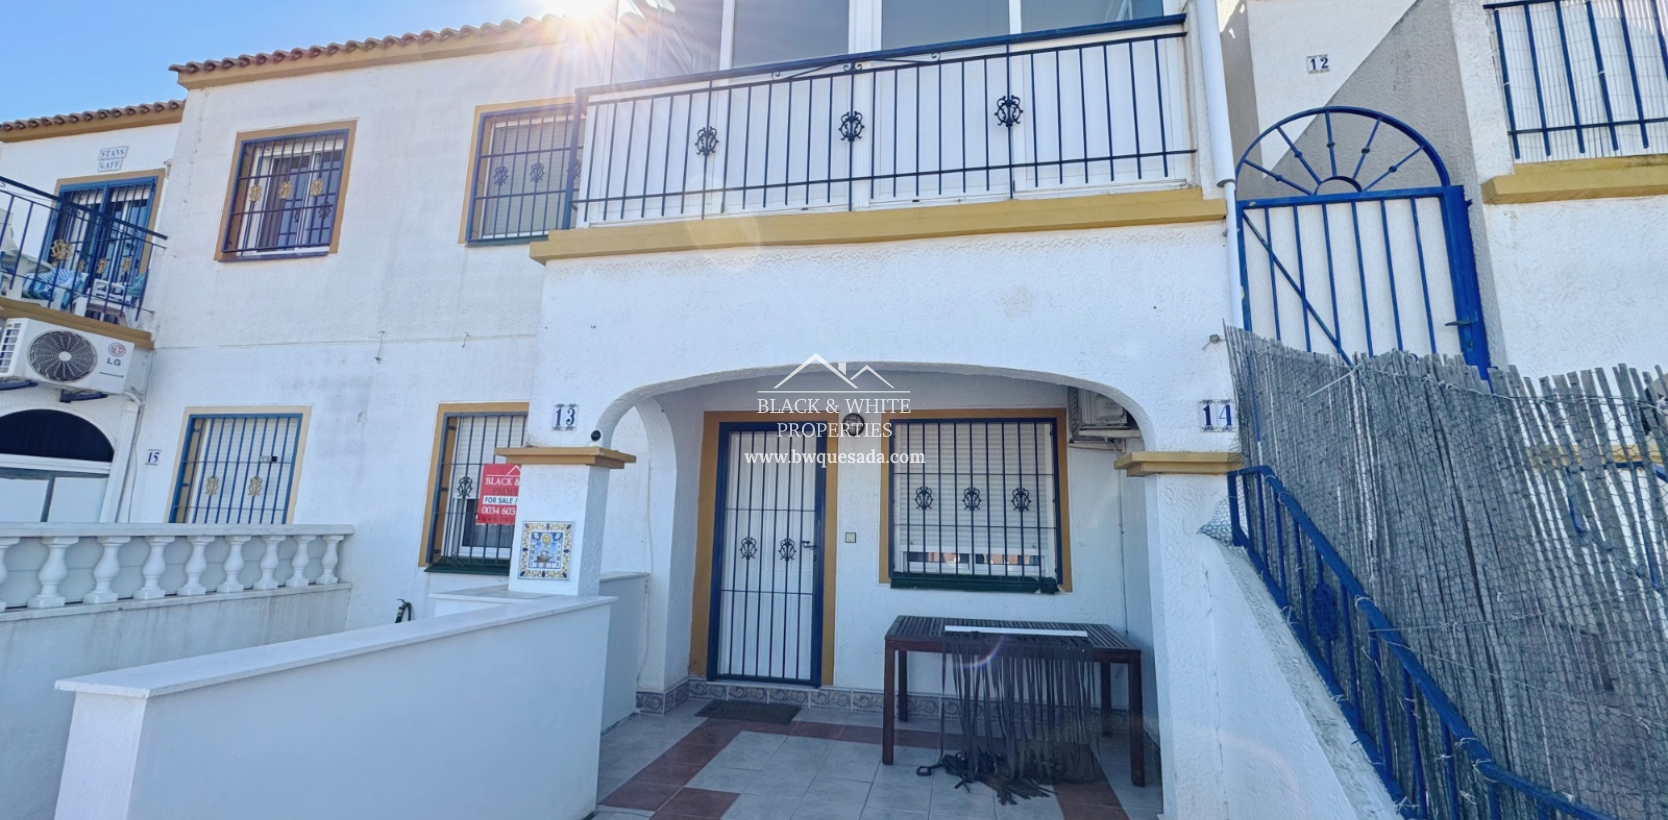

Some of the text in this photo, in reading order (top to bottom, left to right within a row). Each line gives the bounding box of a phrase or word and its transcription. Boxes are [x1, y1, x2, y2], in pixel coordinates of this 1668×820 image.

[1310, 56, 1329, 70] 12
[106, 357, 121, 367] LG
[555, 407, 576, 426] 13
[1203, 404, 1233, 426] 14
[147, 451, 160, 463] 15
[485, 477, 513, 486] BLACK
[484, 496, 497, 504] FOR
[481, 506, 516, 516] 0034 603
